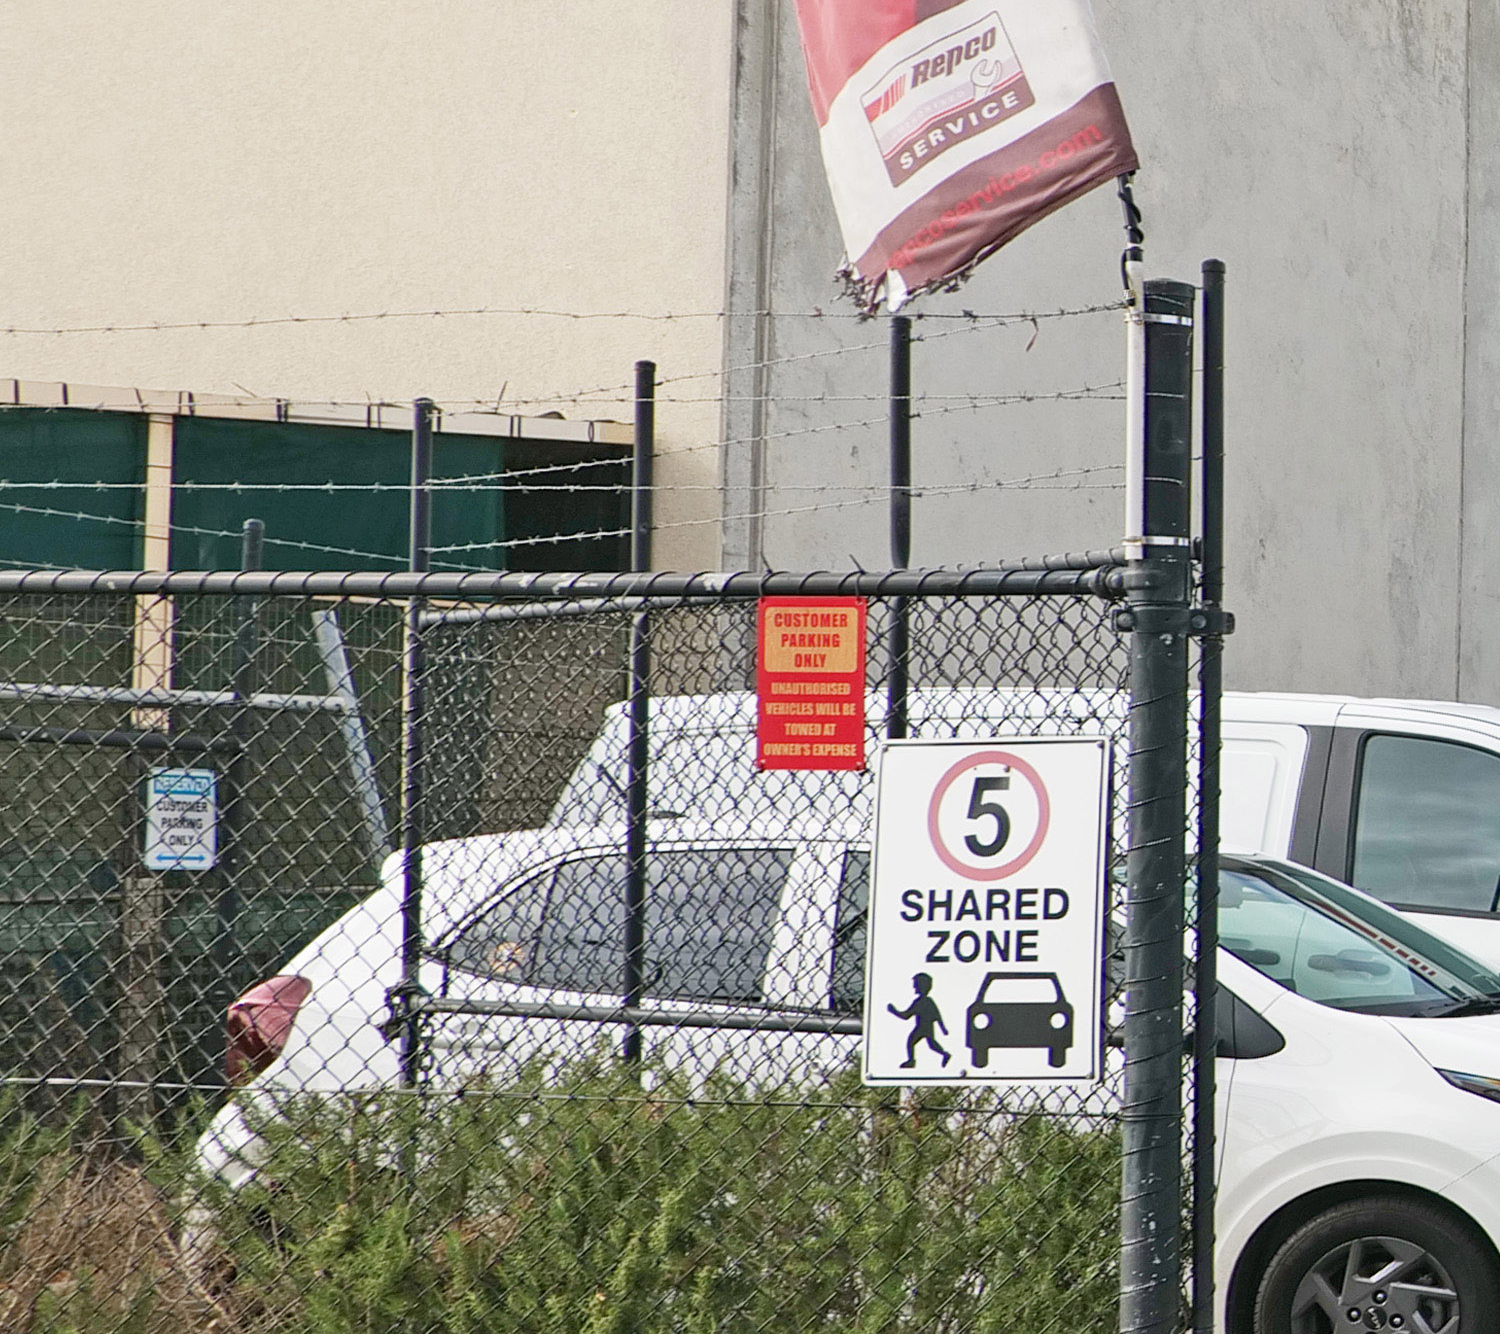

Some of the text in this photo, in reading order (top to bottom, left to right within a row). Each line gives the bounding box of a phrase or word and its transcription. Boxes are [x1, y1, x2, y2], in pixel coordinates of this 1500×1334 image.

[910, 26, 997, 90] Repco
[899, 90, 1021, 170] SERVICE
[774, 613, 849, 627] CUSTOMER
[781, 633, 841, 648] PARKING
[794, 653, 827, 668] ONLY
[770, 682, 851, 695] UNAUTHORISED
[765, 702, 857, 716] VEHICLES WILL BE
[784, 723, 837, 736] TOWED AT
[763, 743, 858, 756] OWNER'S EXPENSE
[964, 776, 1011, 858] 5
[899, 887, 1070, 923] SHARED
[925, 929, 1039, 964] ZONE
